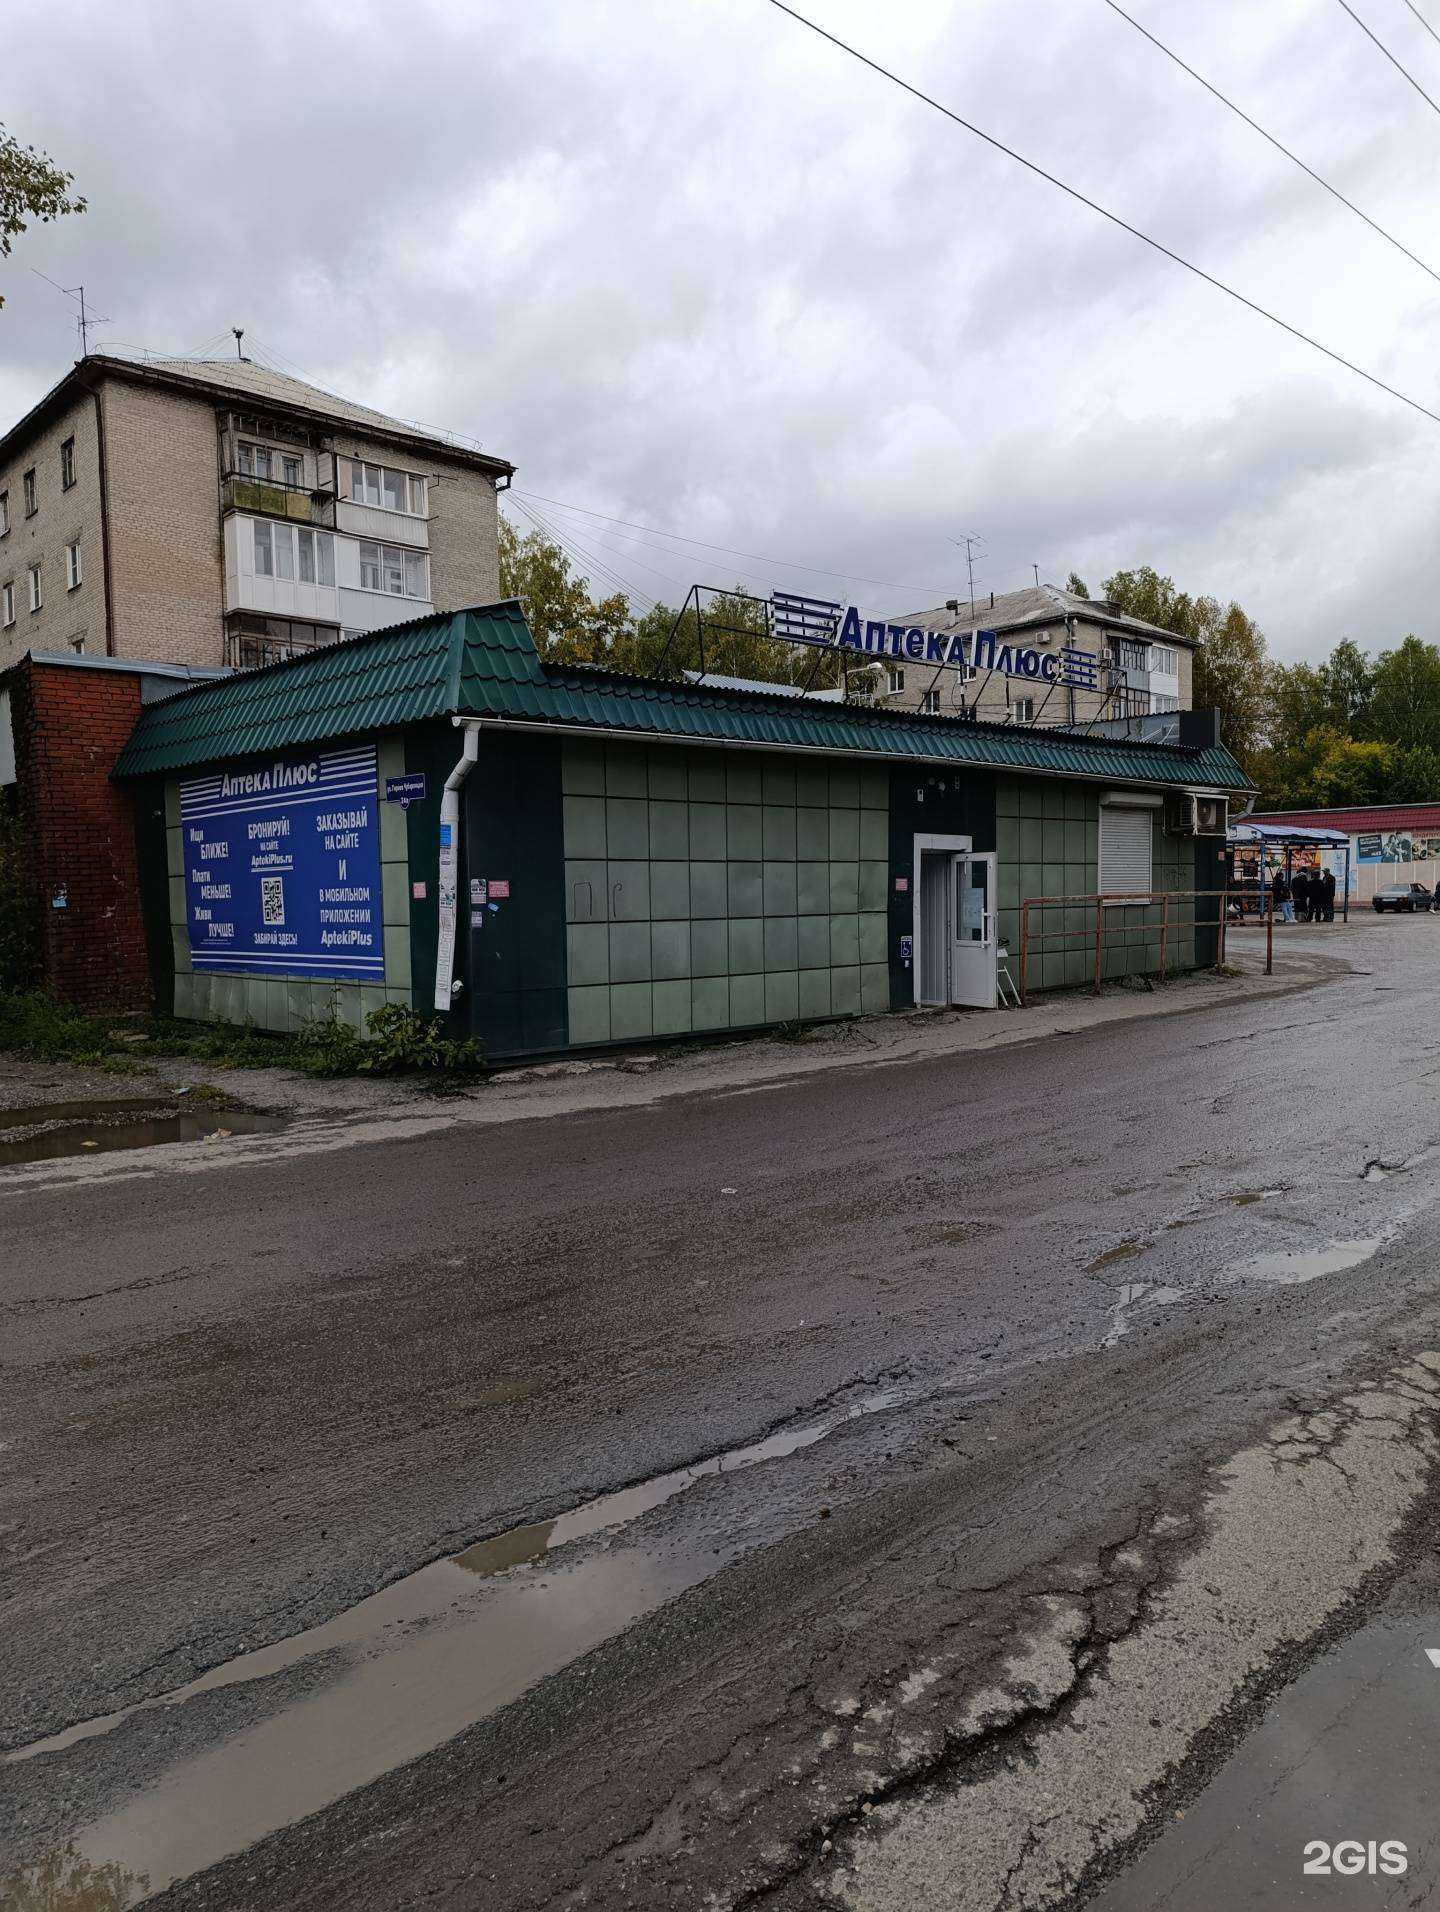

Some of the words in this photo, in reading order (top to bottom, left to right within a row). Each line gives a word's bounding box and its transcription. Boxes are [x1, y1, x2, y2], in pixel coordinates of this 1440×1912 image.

[247, 815, 290, 839] БРОНИРУЙ!
[316, 806, 368, 832] ЗАКАЗЫВАЙ
[190, 828, 204, 842] Ищи
[324, 835, 335, 850] НА
[335, 830, 359, 849] САЙТЕ
[200, 841, 229, 860] БЛИЖЕ!
[251, 853, 293, 868] AptekiPlus.ru
[192, 869, 211, 883] Плати
[338, 859, 347, 881] И
[201, 883, 232, 900] МЕНЬШЕ!
[319, 888, 325, 902] В
[325, 887, 370, 902] МОБИЛЬНОМ
[194, 906, 212, 921] Живи
[320, 909, 371, 923] ПРИЛОЖЕНИИ
[208, 922, 235, 938] ЛУЧШЕ!
[253, 930, 278, 945] ЗАБИРАЙ
[277, 932, 298, 947] ЗДЕСЬ!
[321, 929, 373, 947] AptekiPlus
